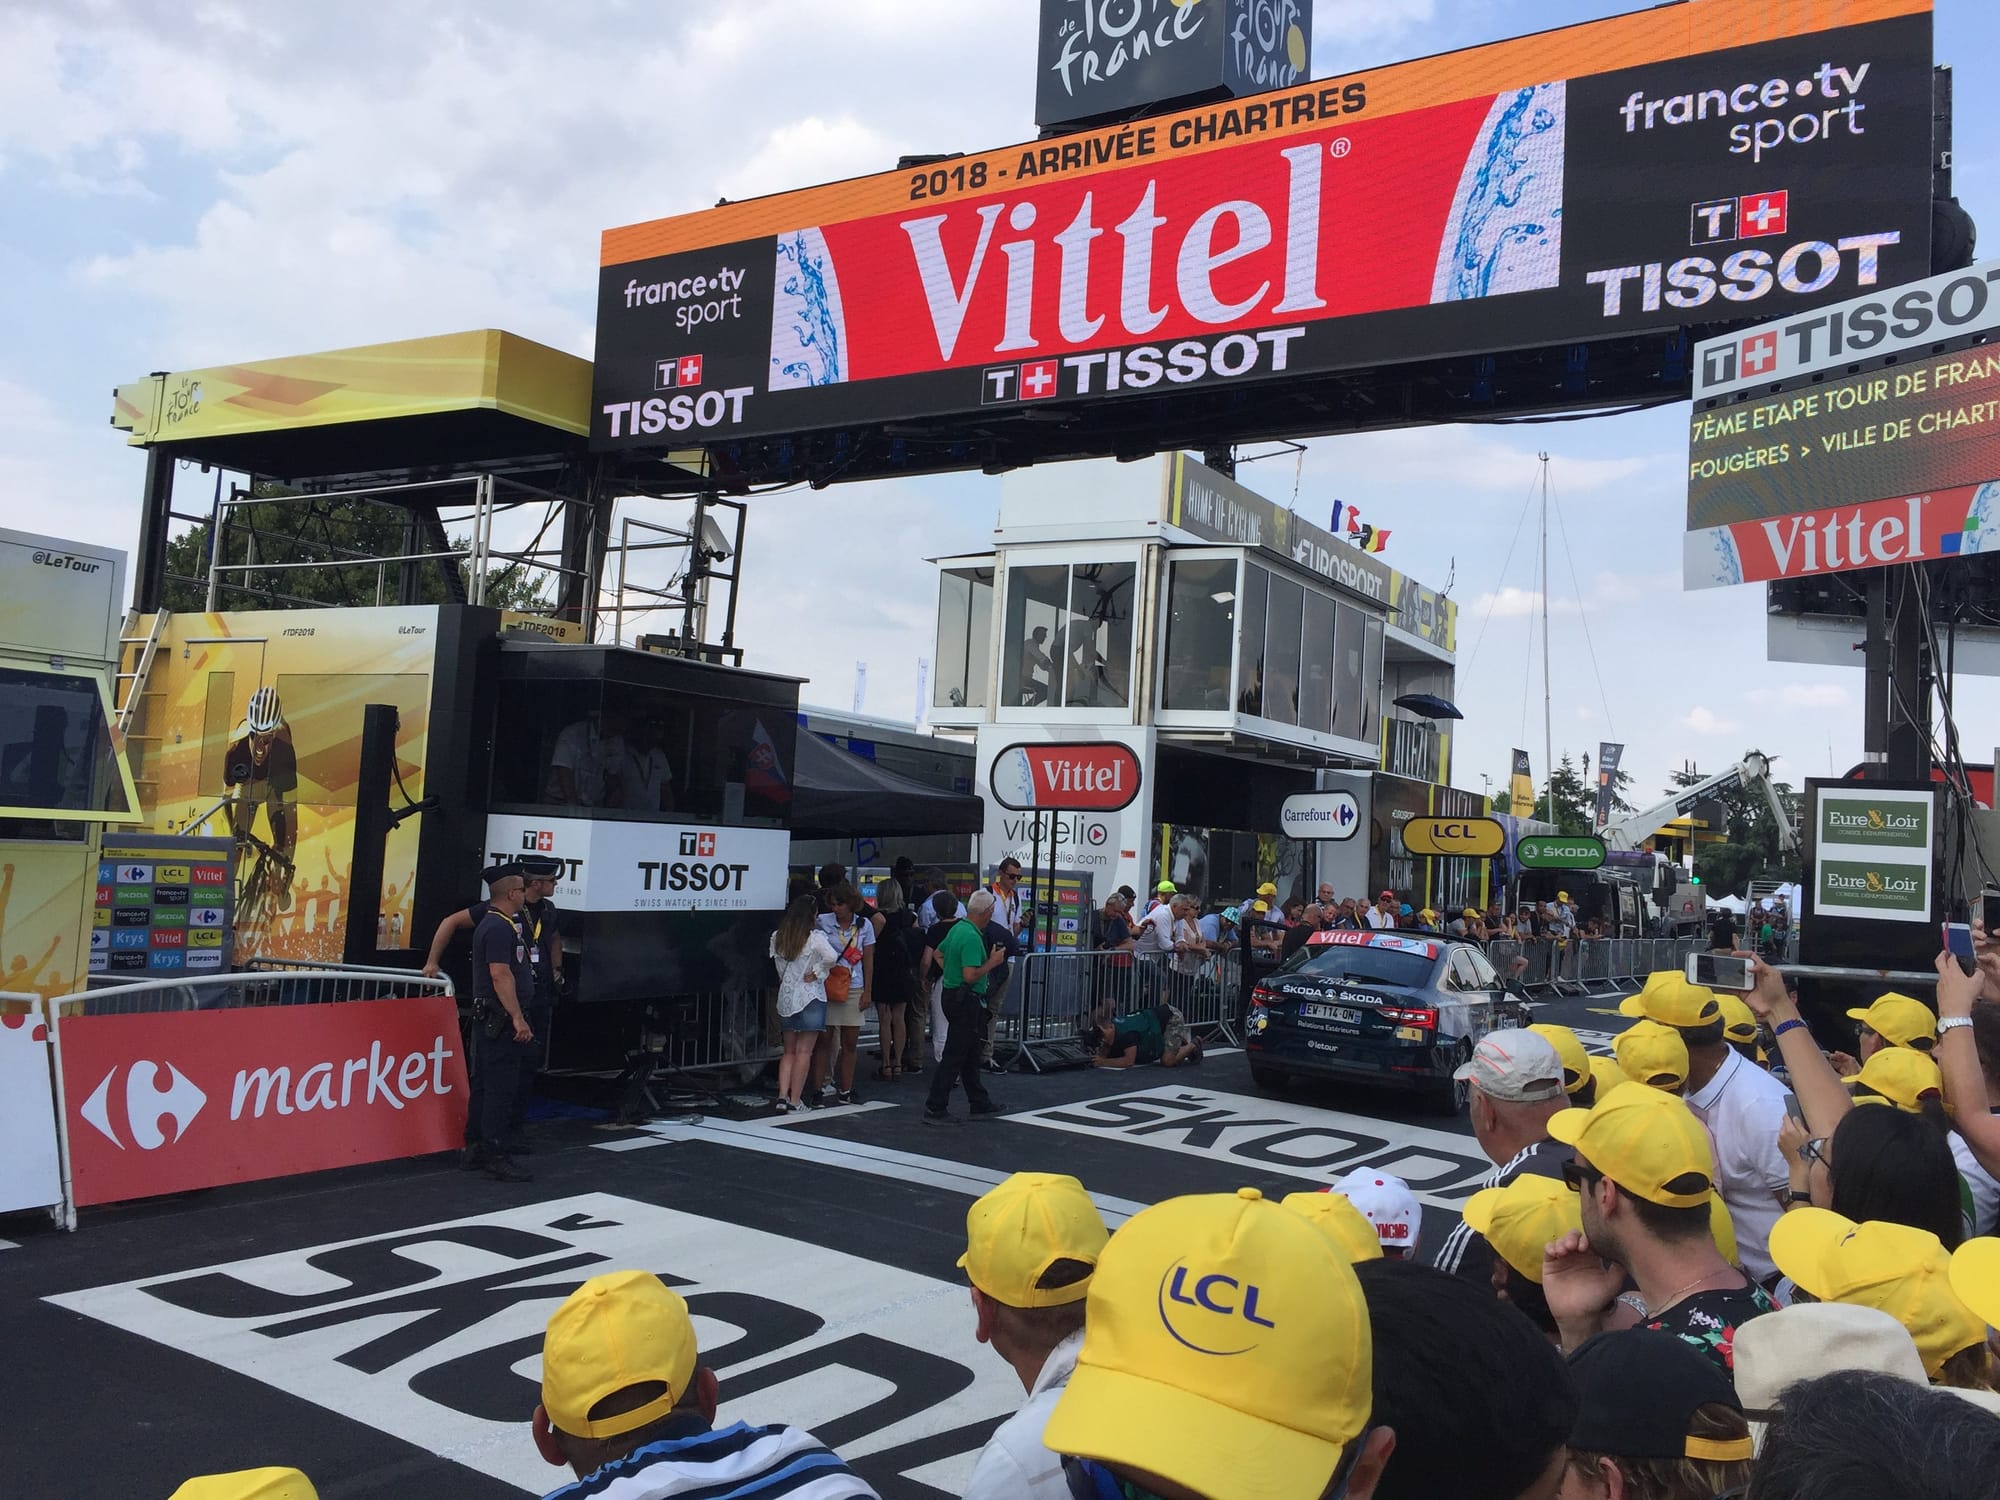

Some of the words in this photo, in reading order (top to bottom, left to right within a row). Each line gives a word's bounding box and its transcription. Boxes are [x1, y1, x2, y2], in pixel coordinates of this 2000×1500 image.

[910, 161, 988, 200] 2018
[1016, 126, 1156, 180] ARRIVÉE
[1169, 82, 1367, 149] CHARTRES
[1728, 100, 1866, 163] sport
[900, 142, 1327, 362] Vittel
[1586, 231, 1901, 317] TISSOT
[675, 293, 742, 335] sport
[1063, 327, 1306, 394] TISSOT
[603, 386, 755, 438] TISSOT
[1692, 412, 1747, 442] 7ÈME
[1752, 395, 1819, 430] ETAPE
[1824, 379, 1888, 413] TOUR
[1894, 369, 1927, 398] DE
[1690, 443, 1790, 480] FOUGÈRES
[1822, 425, 1877, 453] VILLE
[1883, 418, 1912, 442] DE
[1917, 400, 1999, 434] CHART
[1187, 479, 1214, 524] HOME
[1215, 491, 1228, 530] OF
[1227, 500, 1262, 545] CYCLING
[1761, 497, 1925, 576] Vittel
[32, 551, 100, 575] @LeTour
[282, 627, 316, 638] #TDF2018
[1043, 759, 1122, 792] Vittel
[1003, 812, 1108, 846] videlio
[1284, 808, 1332, 823] Carrefour
[1433, 823, 1477, 839] LCL
[1543, 844, 1601, 858] ŠKODA
[196, 870, 223, 881] Vittel
[637, 861, 750, 892] TISSOT
[634, 898, 662, 908] SWISS
[665, 898, 702, 908] WATCHES
[705, 898, 728, 908] SINCE
[116, 932, 144, 946] Krys
[154, 933, 182, 944] Vittel
[1319, 930, 1363, 945] Vittel
[153, 954, 181, 967] Krys
[1282, 984, 1322, 997] ŠKODA
[1340, 991, 1384, 1005] ŠKODA
[1297, 1020, 1325, 1031] Relations
[229, 1035, 454, 1121] market
[1169, 1266, 1275, 1329] LCL
